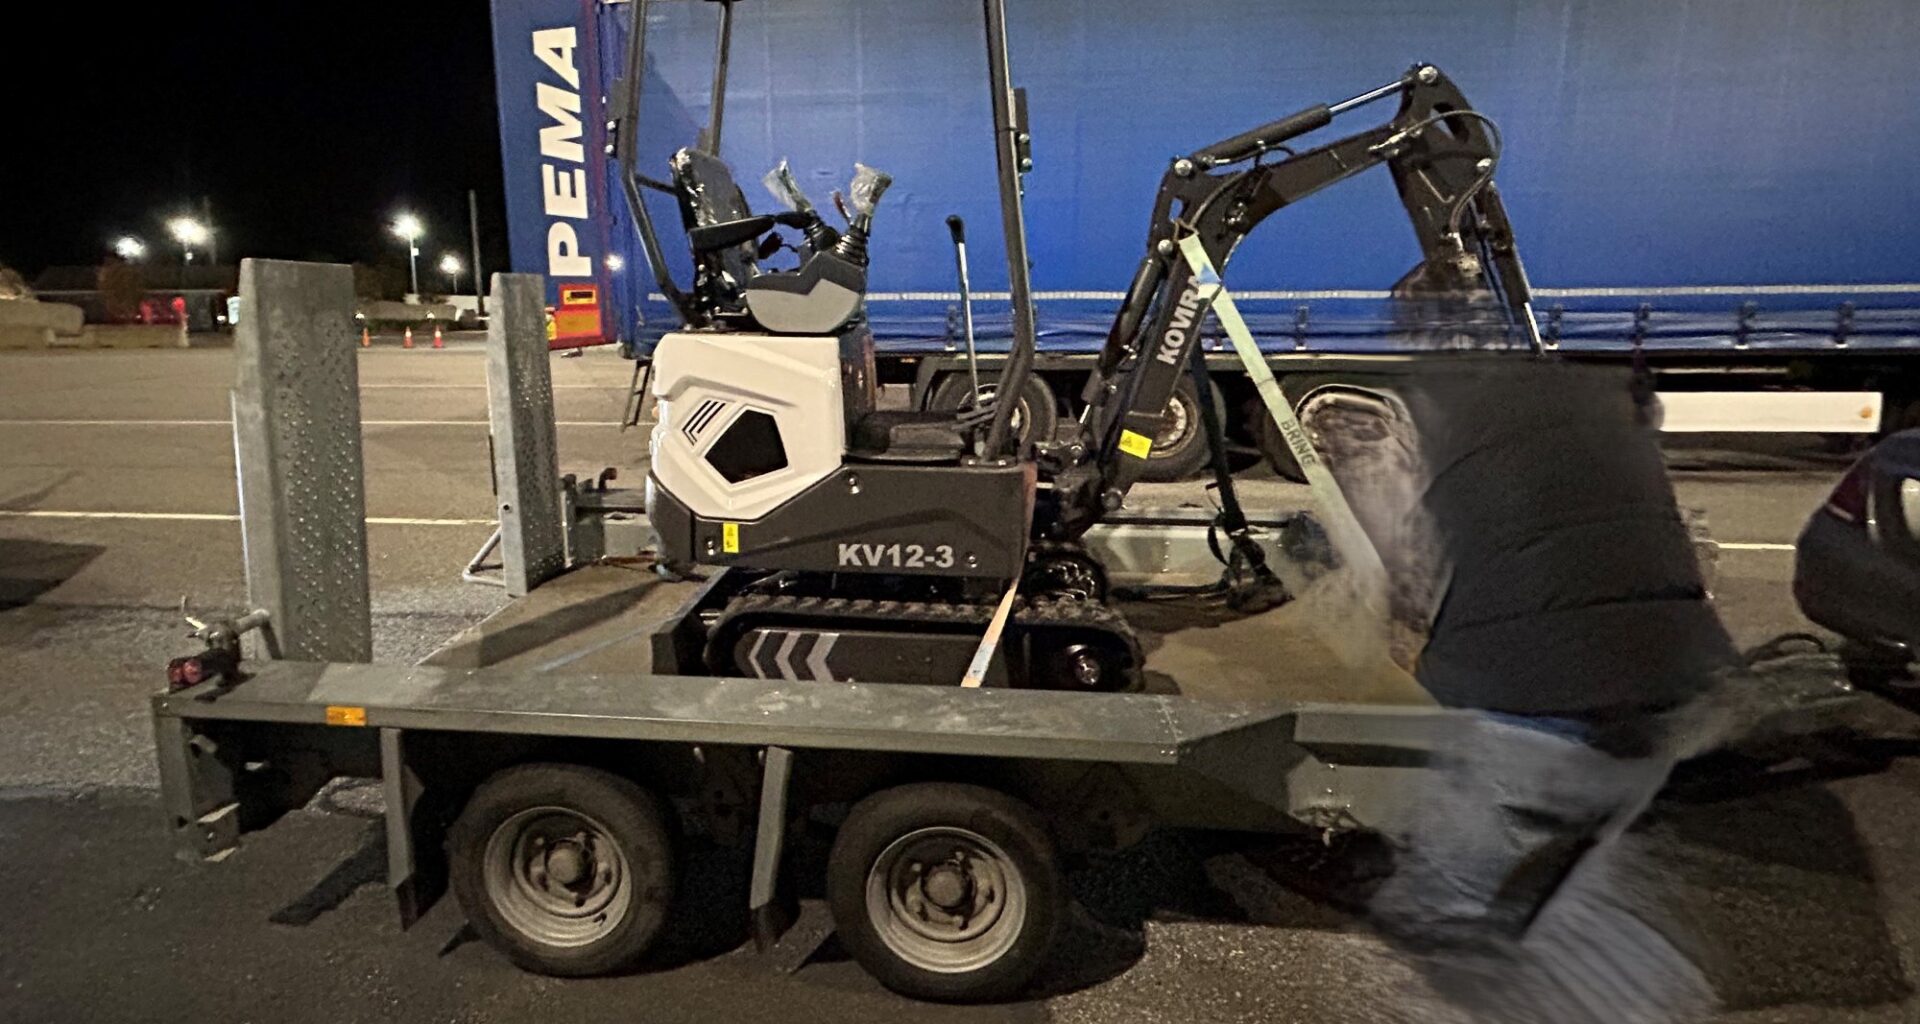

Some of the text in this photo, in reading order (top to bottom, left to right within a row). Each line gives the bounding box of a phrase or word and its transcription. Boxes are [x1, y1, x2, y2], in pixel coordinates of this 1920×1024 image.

[532, 27, 592, 277] PEMA
[1280, 420, 1316, 466] BRING
[838, 543, 955, 568] KV12-3
